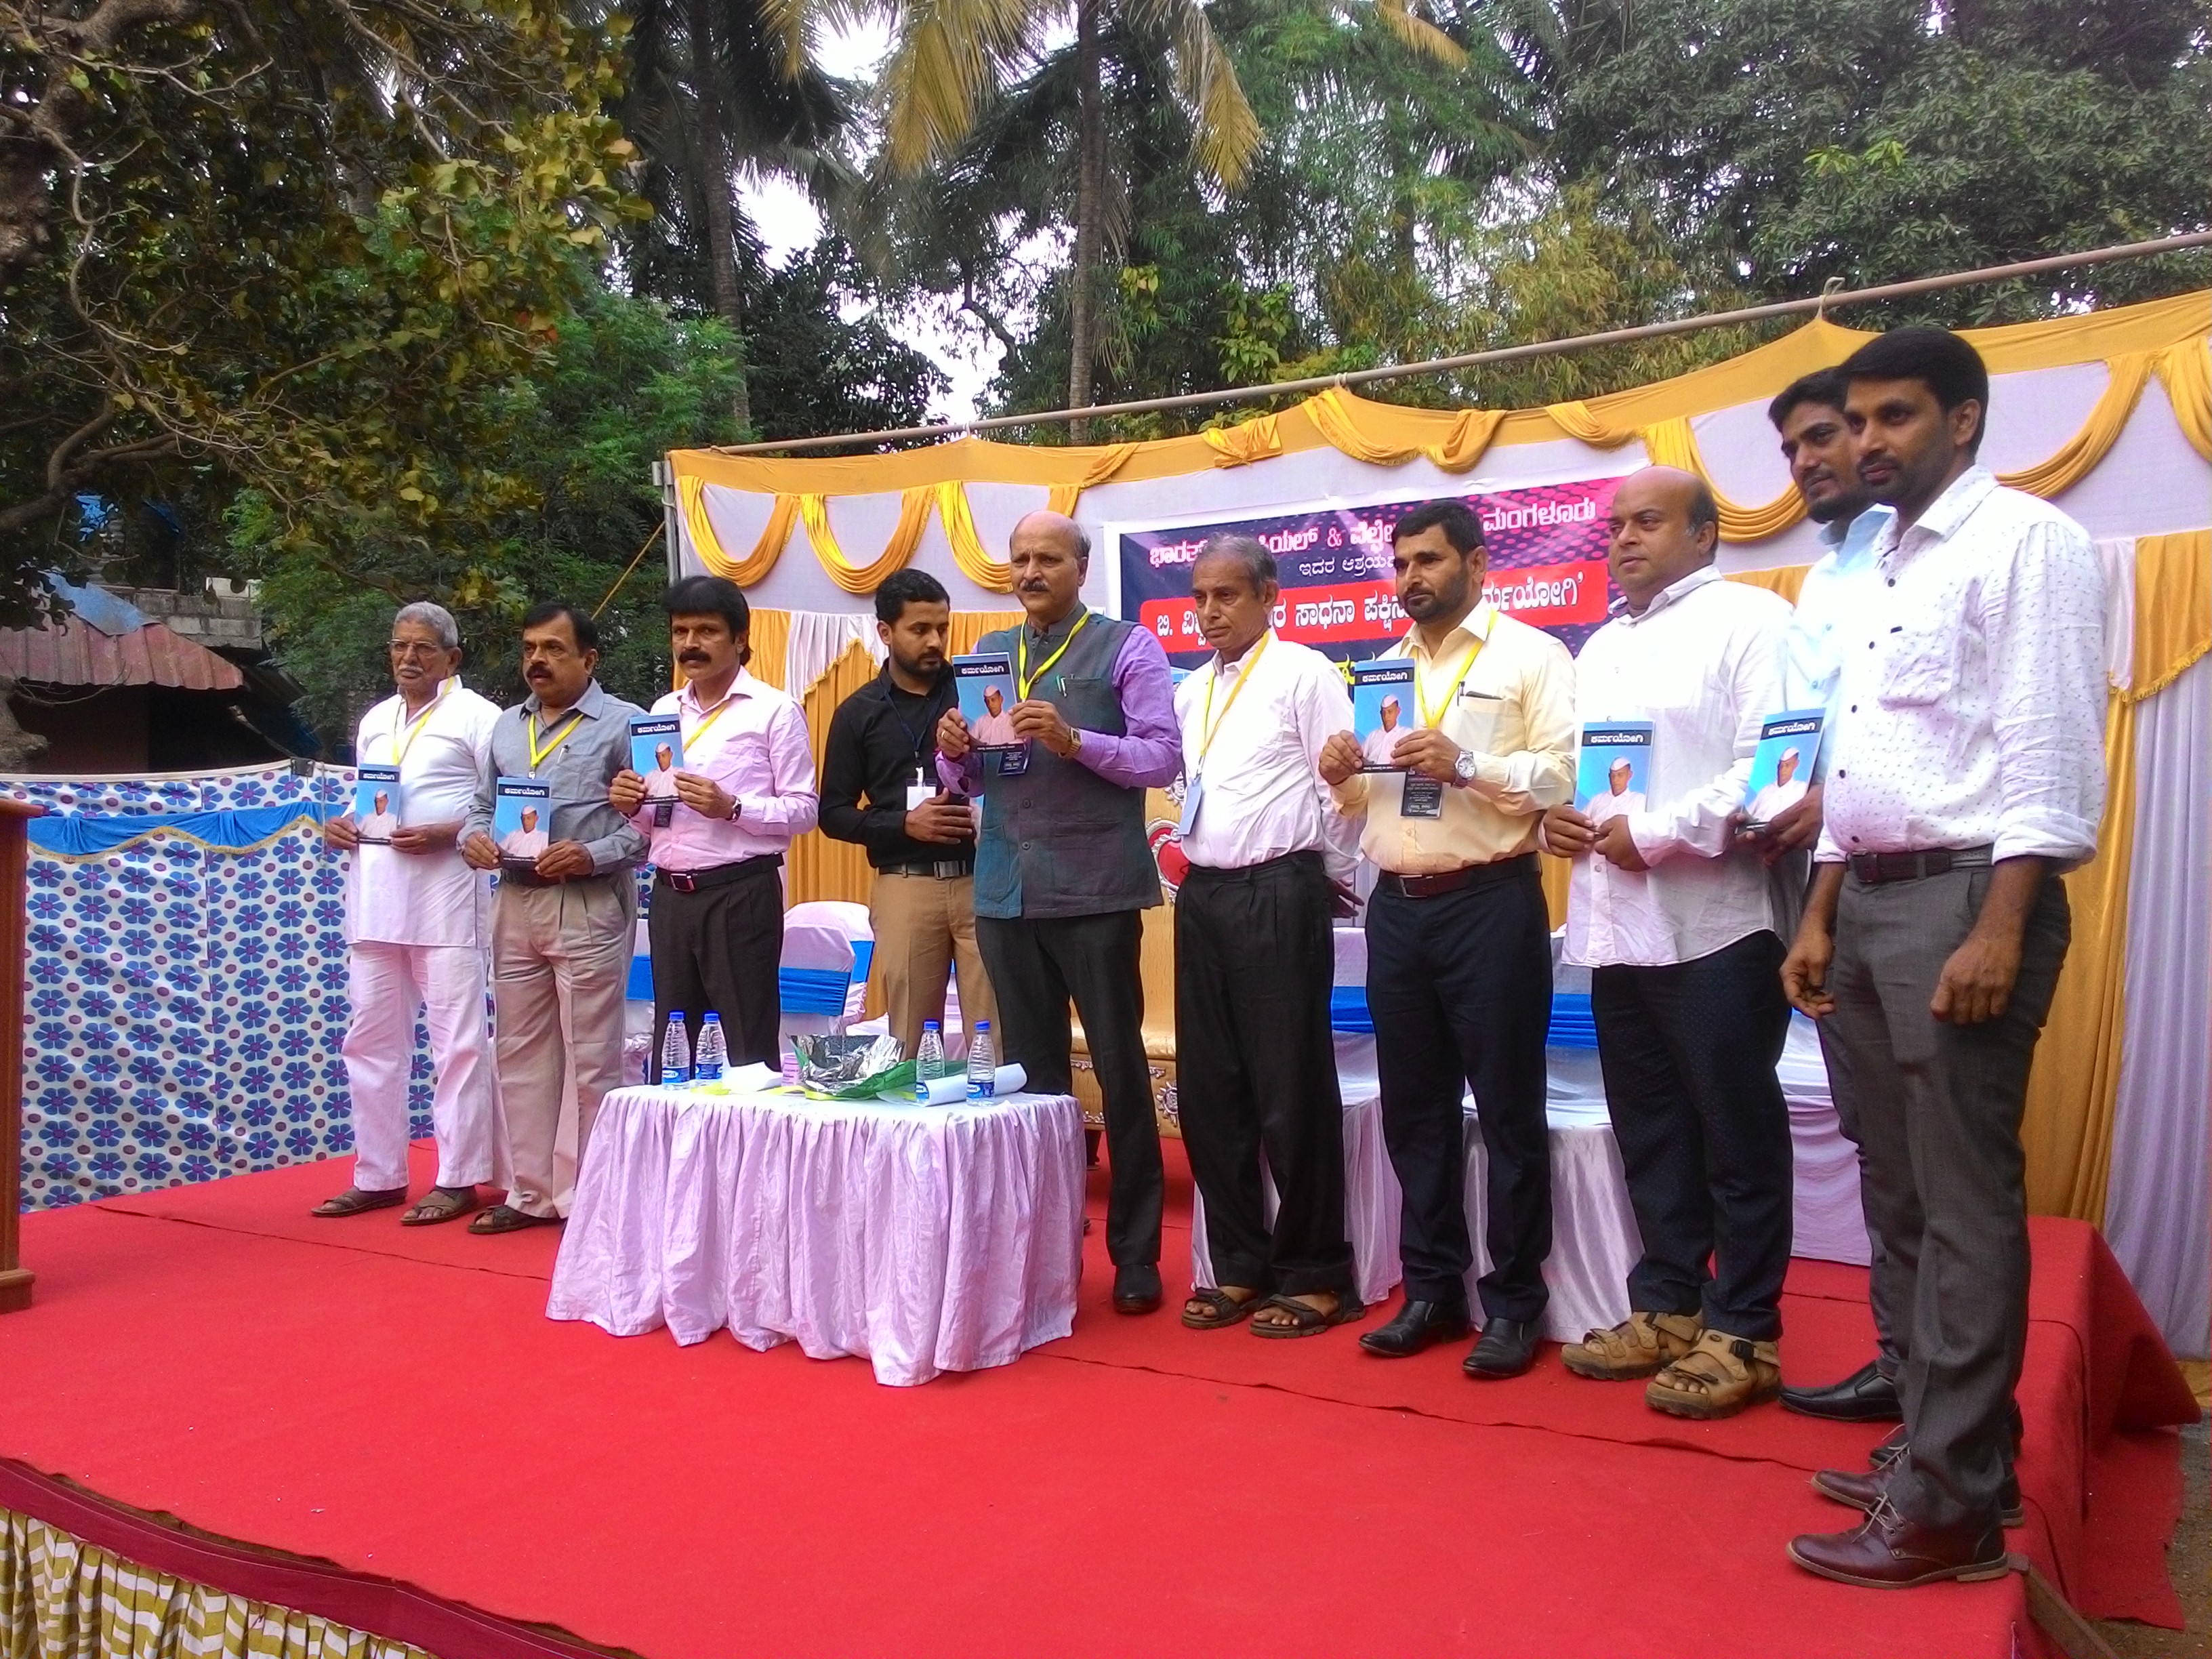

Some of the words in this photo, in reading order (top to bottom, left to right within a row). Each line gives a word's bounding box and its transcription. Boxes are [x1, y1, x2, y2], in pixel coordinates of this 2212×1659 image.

[1327, 527, 1343, 548] &
[1483, 497, 1596, 532] ಮಂಗಳೂರು
[1298, 557, 1335, 577] ಇದರ
[1157, 615, 1173, 636] ಬಿ.
[1295, 594, 1355, 630] ಸಾಧನಾ
[961, 664, 1004, 675] ಕರ್ಮಯೋಗಿ
[1362, 671, 1408, 683] ಕರ್ಮಯೋಗಿ
[1767, 720, 1816, 737] ಕರ್ಮಯೋಗಿ
[1590, 732, 1644, 744] ಕರ್ಮಯೋಗಿ
